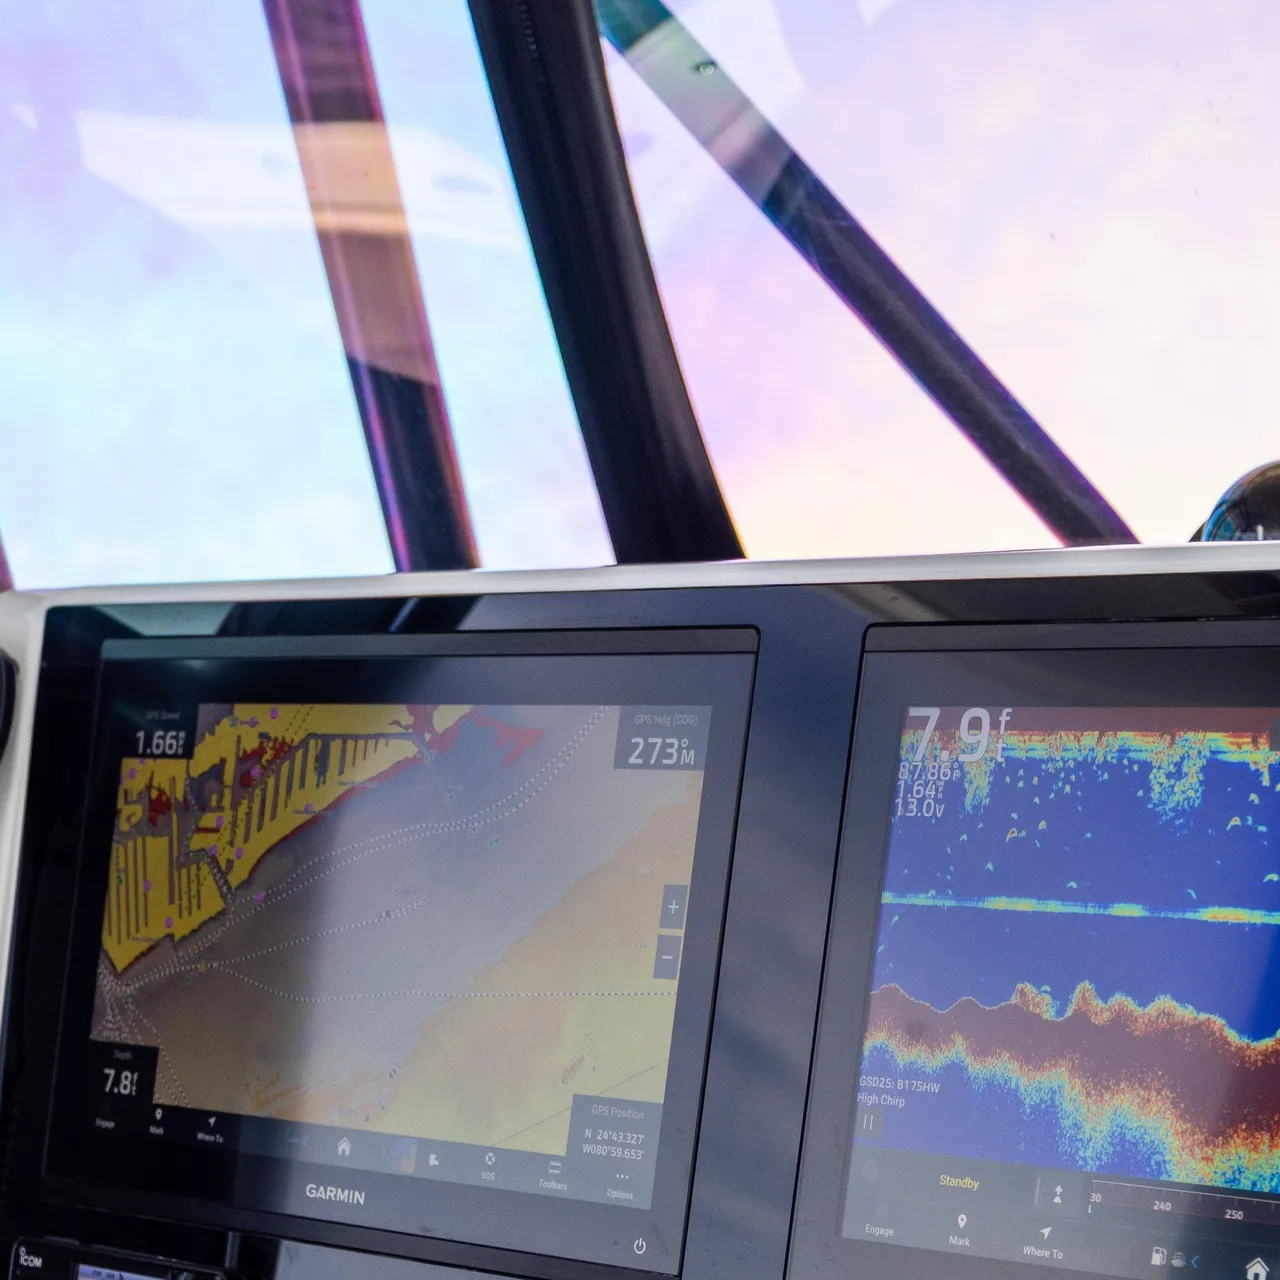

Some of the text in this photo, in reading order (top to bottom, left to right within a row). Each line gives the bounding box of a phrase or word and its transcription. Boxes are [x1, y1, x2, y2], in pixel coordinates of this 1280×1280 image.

[634, 714, 652, 725] GPS
[859, 1076, 940, 1093] GSD25: B175HW
[857, 1093, 905, 1109] High Chirp
[592, 1104, 645, 1120] GPS Position
[481, 1171, 496, 1181] SOS
[939, 1175, 979, 1191] Standby
[539, 1179, 568, 1192] Toolbars
[306, 1184, 365, 1205] GARMIN
[607, 1188, 633, 1201] Options
[1225, 1209, 1244, 1220] 250
[865, 1223, 894, 1237] Engage
[949, 1235, 970, 1247] Mark
[1023, 1245, 1064, 1260] Where To
